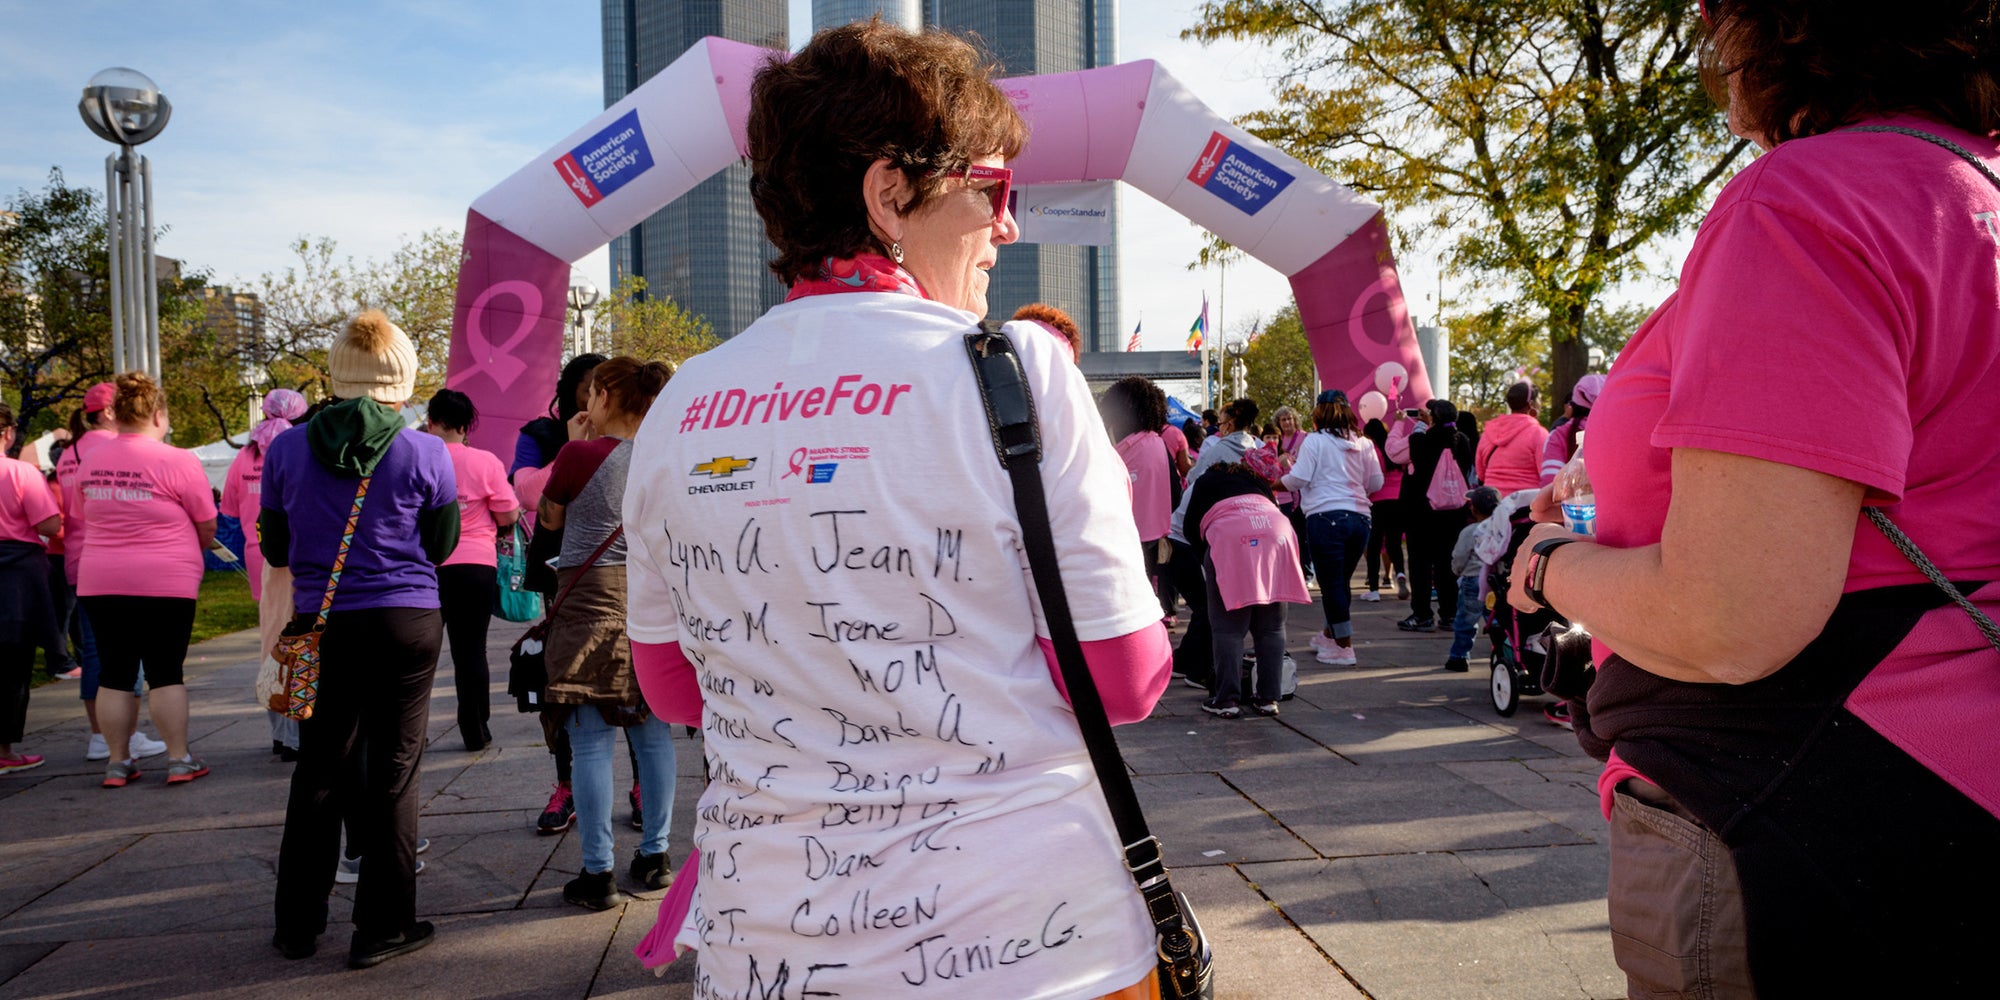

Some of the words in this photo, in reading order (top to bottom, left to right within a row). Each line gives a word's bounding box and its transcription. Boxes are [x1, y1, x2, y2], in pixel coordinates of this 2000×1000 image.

[582, 127, 636, 166] American
[587, 144, 626, 174] Cancer
[1221, 162, 1259, 189] Cancer
[1225, 154, 1278, 189] American
[1042, 206, 1106, 218] CooperStandard
[679, 374, 912, 434] #IDriveFor
[809, 447, 839, 455] MAKING
[841, 446, 870, 454] STRIDES
[688, 480, 756, 495] CHEVROLET
[1249, 515, 1272, 530] HOPE
[663, 519, 724, 601] Lynn
[810, 509, 915, 578] Jean
[933, 527, 973, 583] M.
[806, 601, 904, 643] Irene
[848, 645, 947, 694] MOM
[722, 841, 742, 883] S.
[901, 934, 1041, 986] Janice
